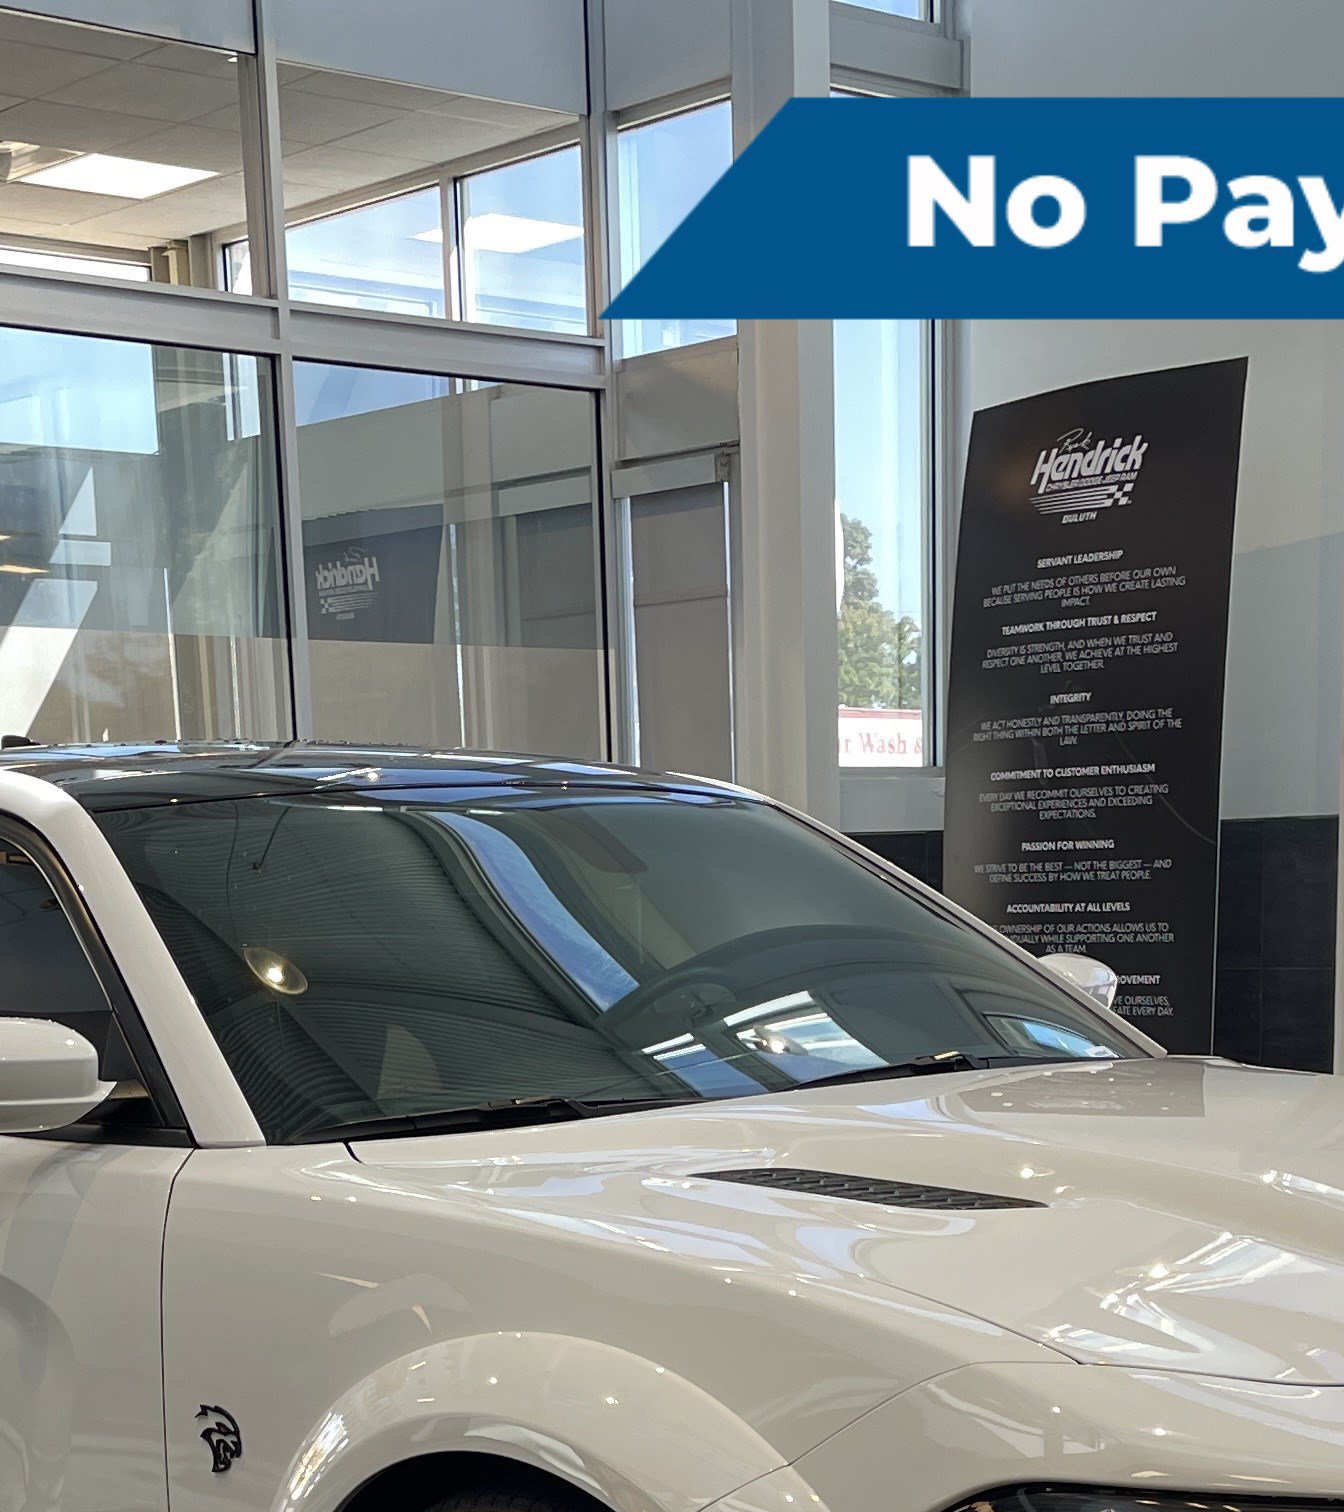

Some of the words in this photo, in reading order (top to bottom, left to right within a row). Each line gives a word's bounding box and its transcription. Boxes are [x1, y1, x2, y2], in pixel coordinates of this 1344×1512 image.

[1030, 435, 1149, 494] Hendrick
[1061, 511, 1097, 524] DULUTH
[1037, 555, 1072, 568] SERVANT
[1074, 550, 1124, 564] LEADERSHIP
[1002, 623, 1044, 635] TEAMWORK
[1046, 619, 1086, 631] THROUGH
[1087, 615, 1112, 627] TRUST
[1113, 615, 1119, 624] &
[1121, 612, 1157, 623] RESPECT
[1050, 692, 1091, 704] INTEGRITY
[858, 731, 908, 755] Wash
[991, 770, 1041, 781] COMMITMENT
[1043, 769, 1054, 777] TO
[1055, 766, 1100, 778] CUSTOMER
[1101, 763, 1155, 775] ENTHUSIASM
[1021, 841, 1055, 851] PASSION
[1057, 841, 1074, 850] FOR
[1075, 839, 1114, 849] WINNING
[1006, 903, 1073, 914] ACCOUNTABILITY
[1075, 903, 1086, 912] AT
[1087, 902, 1101, 912] ALL
[1102, 902, 1130, 911] LEVELS
